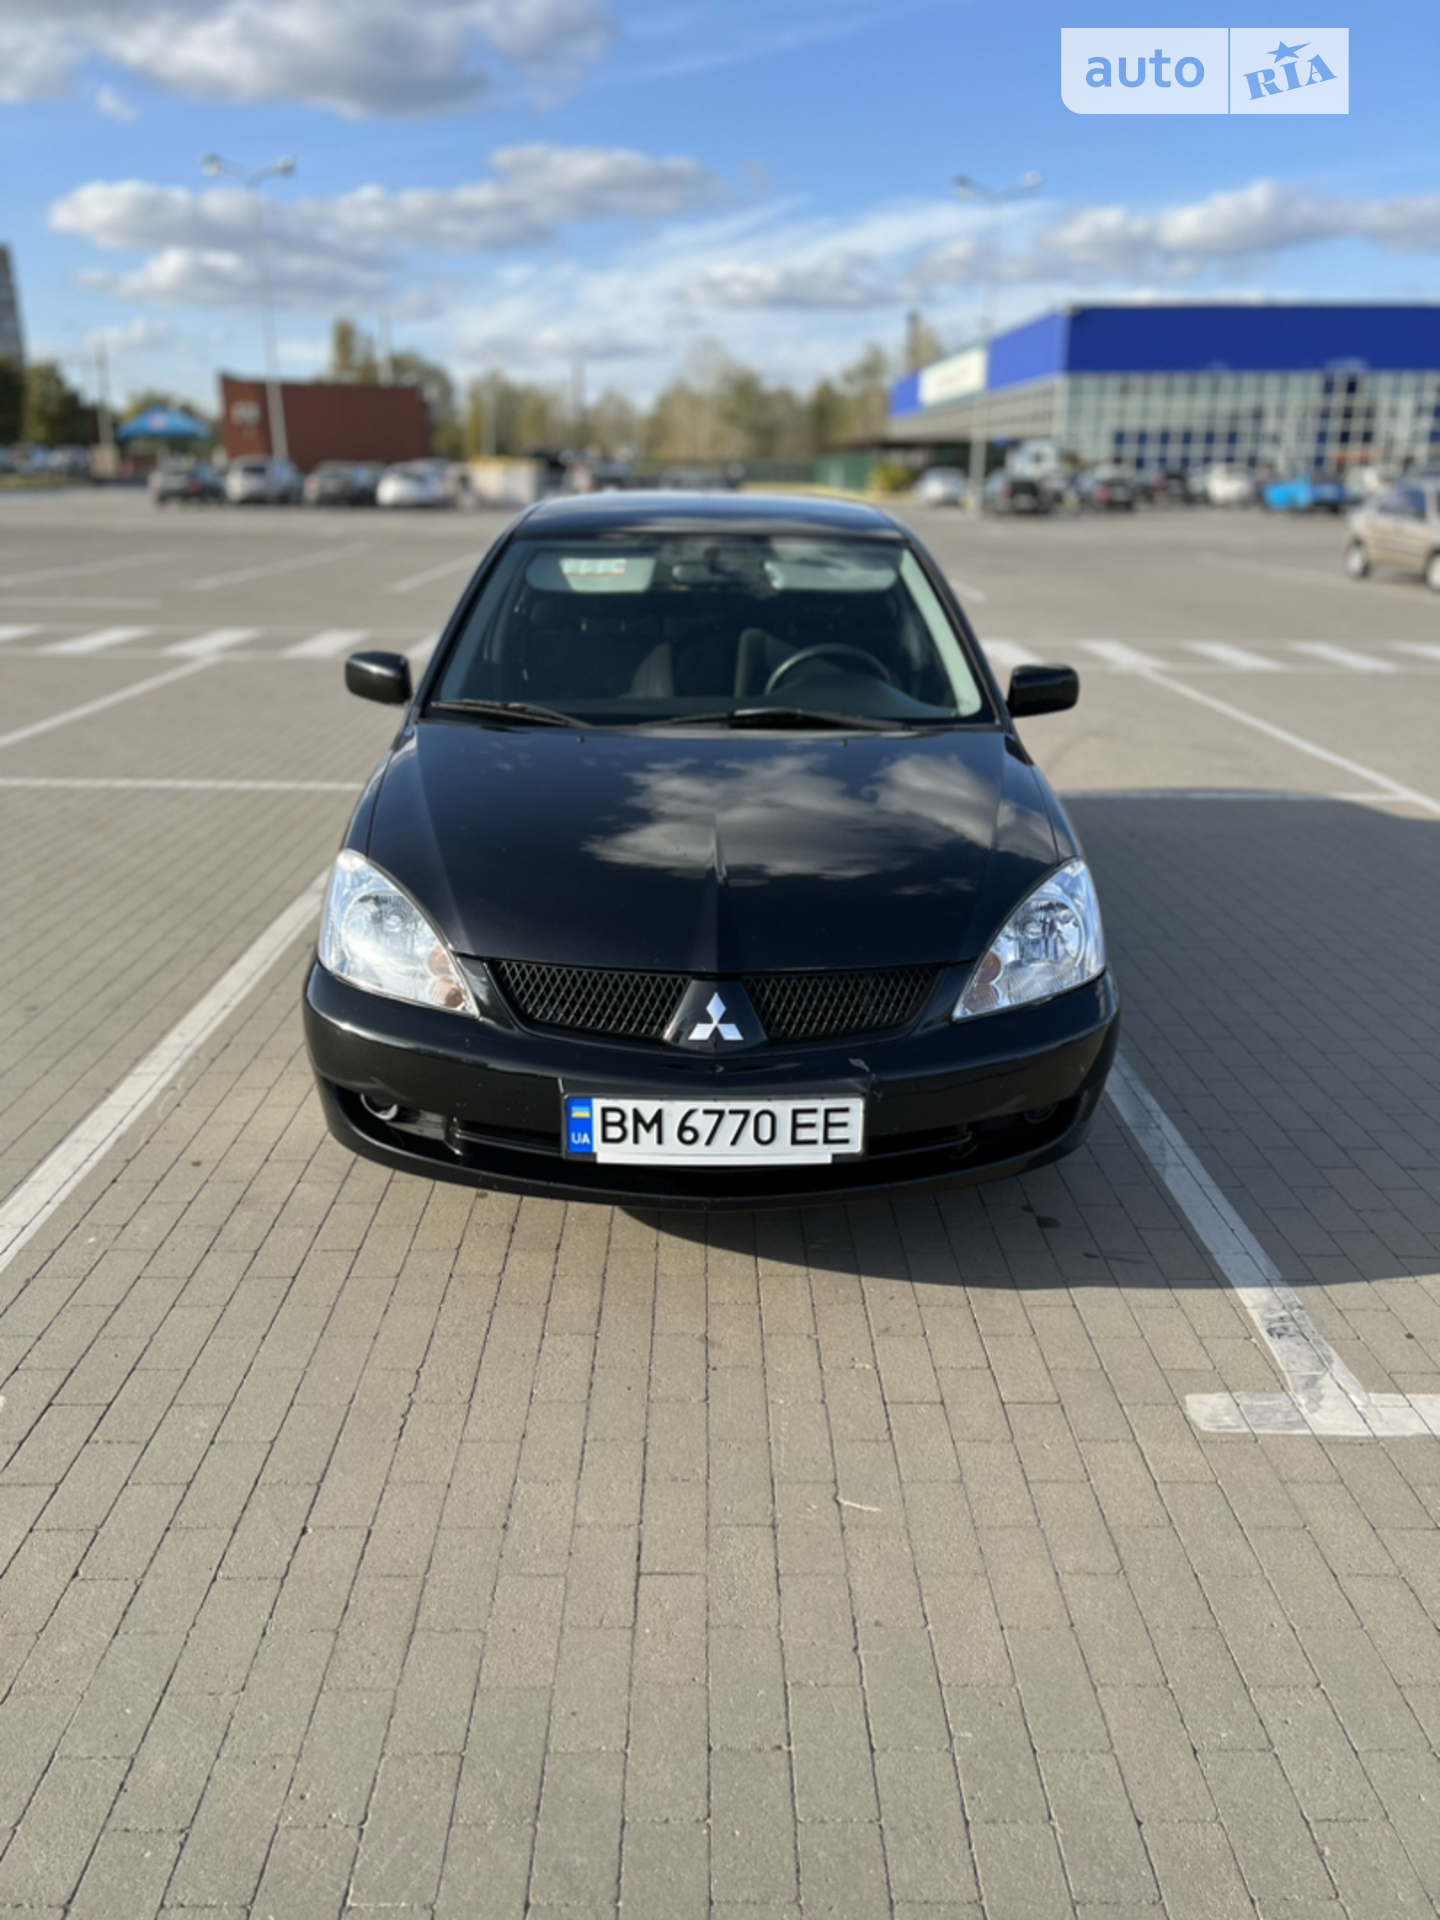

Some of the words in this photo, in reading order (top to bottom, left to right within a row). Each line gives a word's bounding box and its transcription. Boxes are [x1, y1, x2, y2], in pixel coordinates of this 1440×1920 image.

[571, 1132, 591, 1145] UA
[600, 1106, 664, 1146] BM
[676, 1106, 777, 1147] 6770
[790, 1106, 851, 1146] EE
